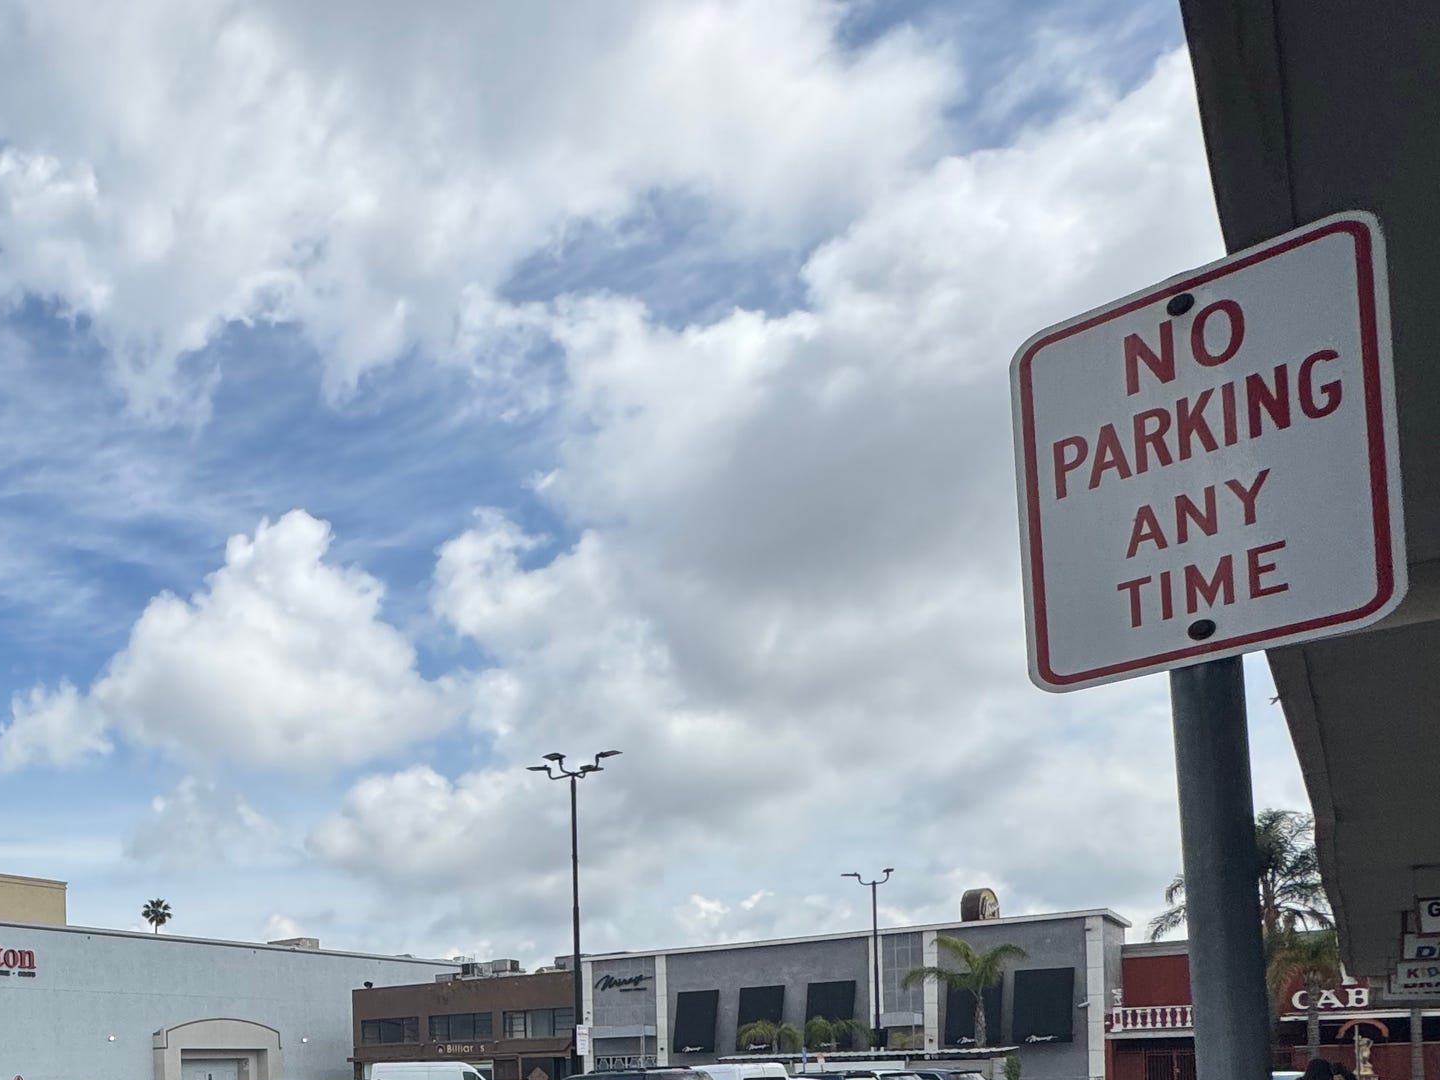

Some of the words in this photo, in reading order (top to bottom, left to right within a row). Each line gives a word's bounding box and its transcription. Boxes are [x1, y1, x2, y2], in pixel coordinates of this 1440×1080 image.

[1124, 298, 1246, 397] NO
[1052, 349, 1343, 500] PARKING
[1126, 468, 1272, 560] ANY
[1117, 540, 1290, 628] TIME
